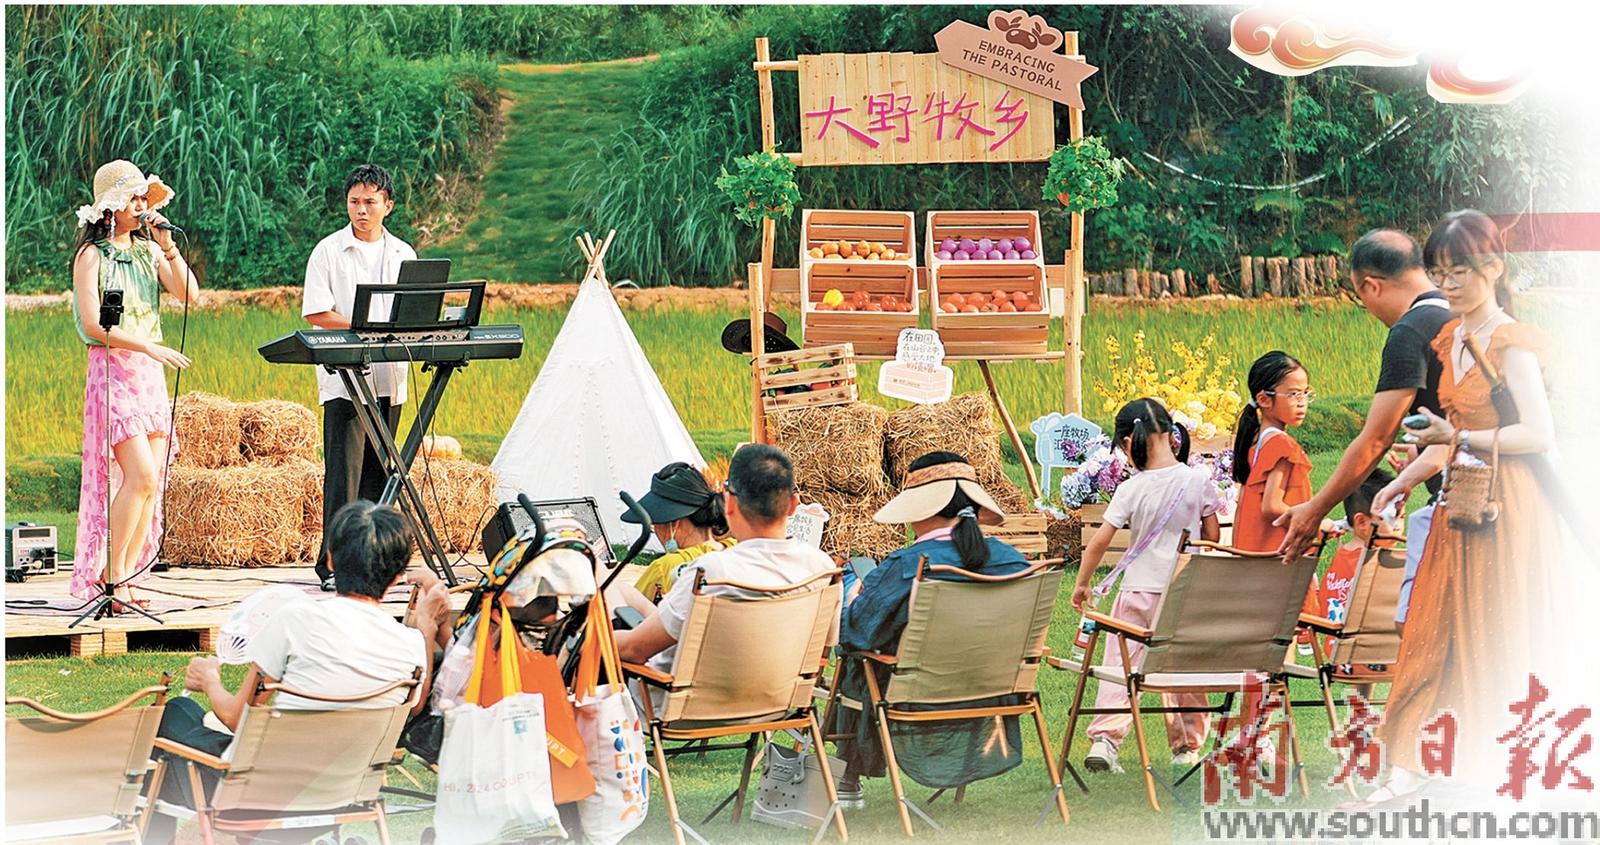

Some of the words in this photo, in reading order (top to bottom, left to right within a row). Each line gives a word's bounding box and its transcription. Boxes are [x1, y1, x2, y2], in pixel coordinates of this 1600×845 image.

[962, 49, 986, 65] THE
[991, 59, 1062, 91] PASTORAL
[978, 40, 1055, 73] EMBRACING
[805, 90, 1029, 151] 大野牧乡
[318, 336, 347, 344] YAMAHA
[1054, 424, 1089, 441] 一座牧场
